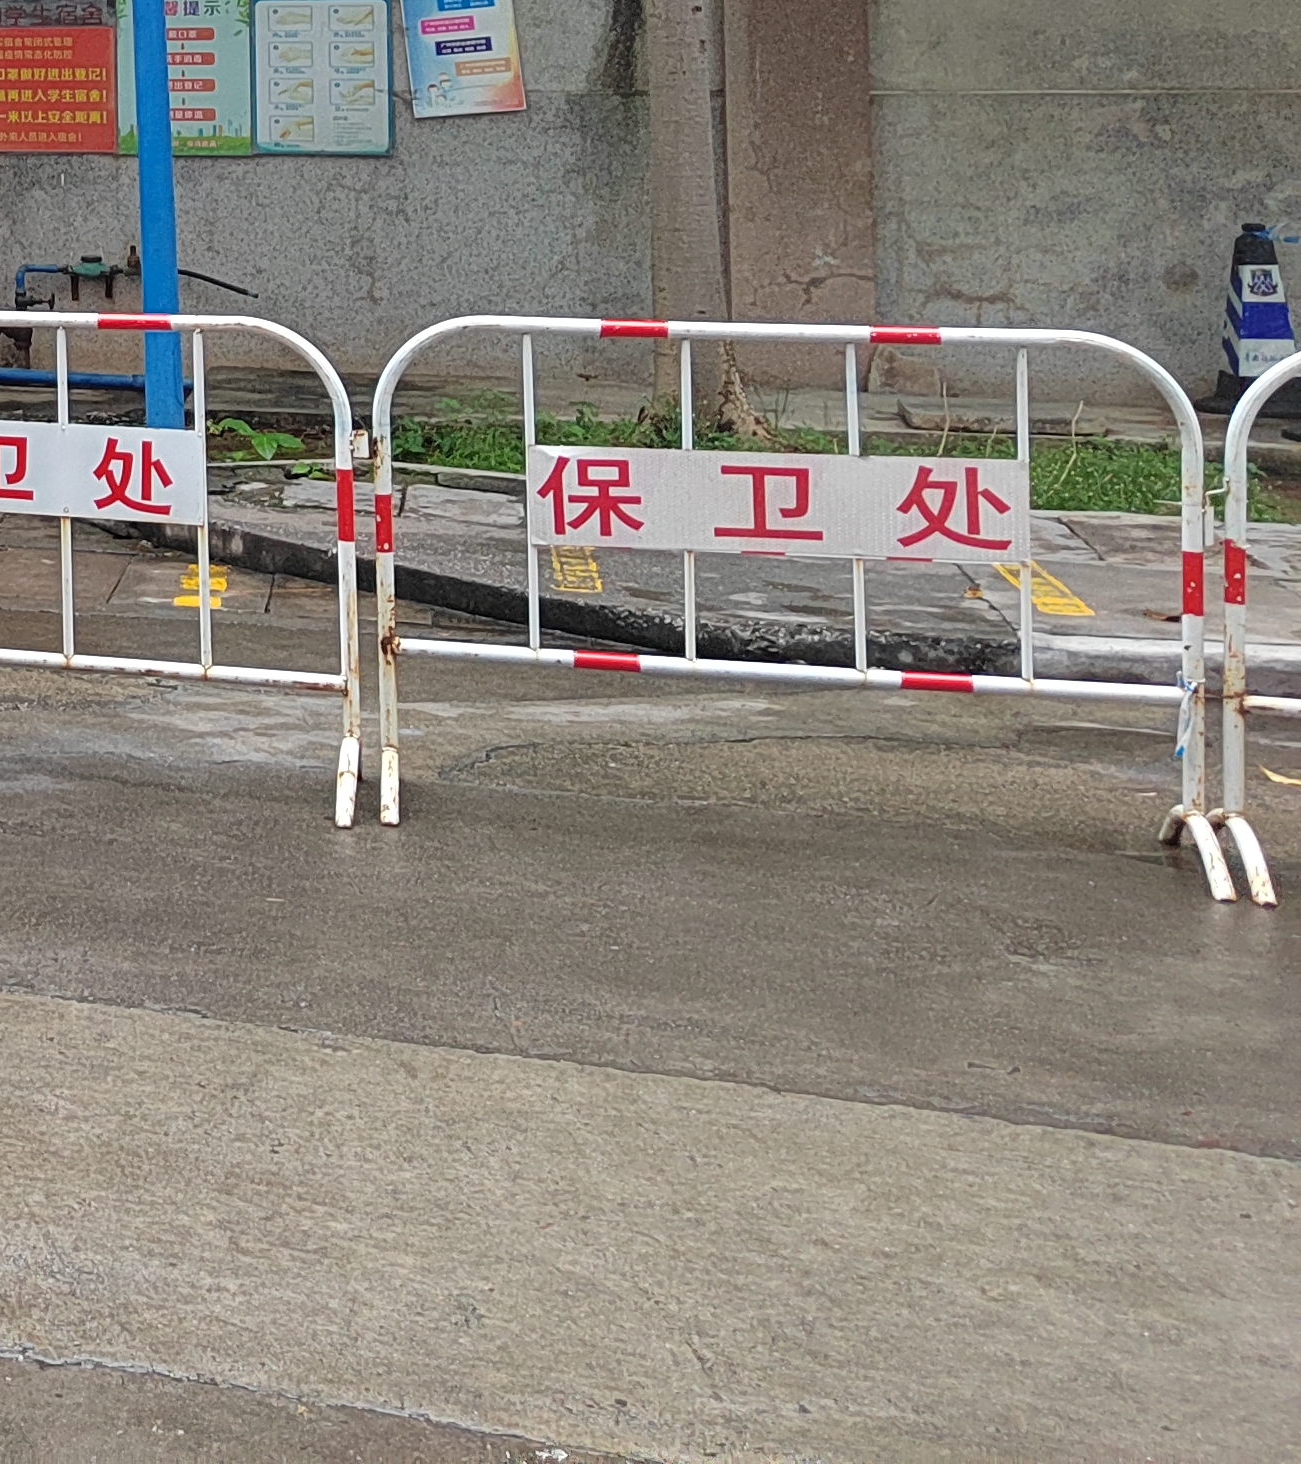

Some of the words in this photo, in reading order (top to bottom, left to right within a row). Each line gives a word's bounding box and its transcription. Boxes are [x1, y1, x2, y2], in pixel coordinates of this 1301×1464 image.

[164, 0, 221, 16] 馨提示
[168, 30, 197, 39] 戴口罩
[536, 454, 1012, 552] 保卫处
